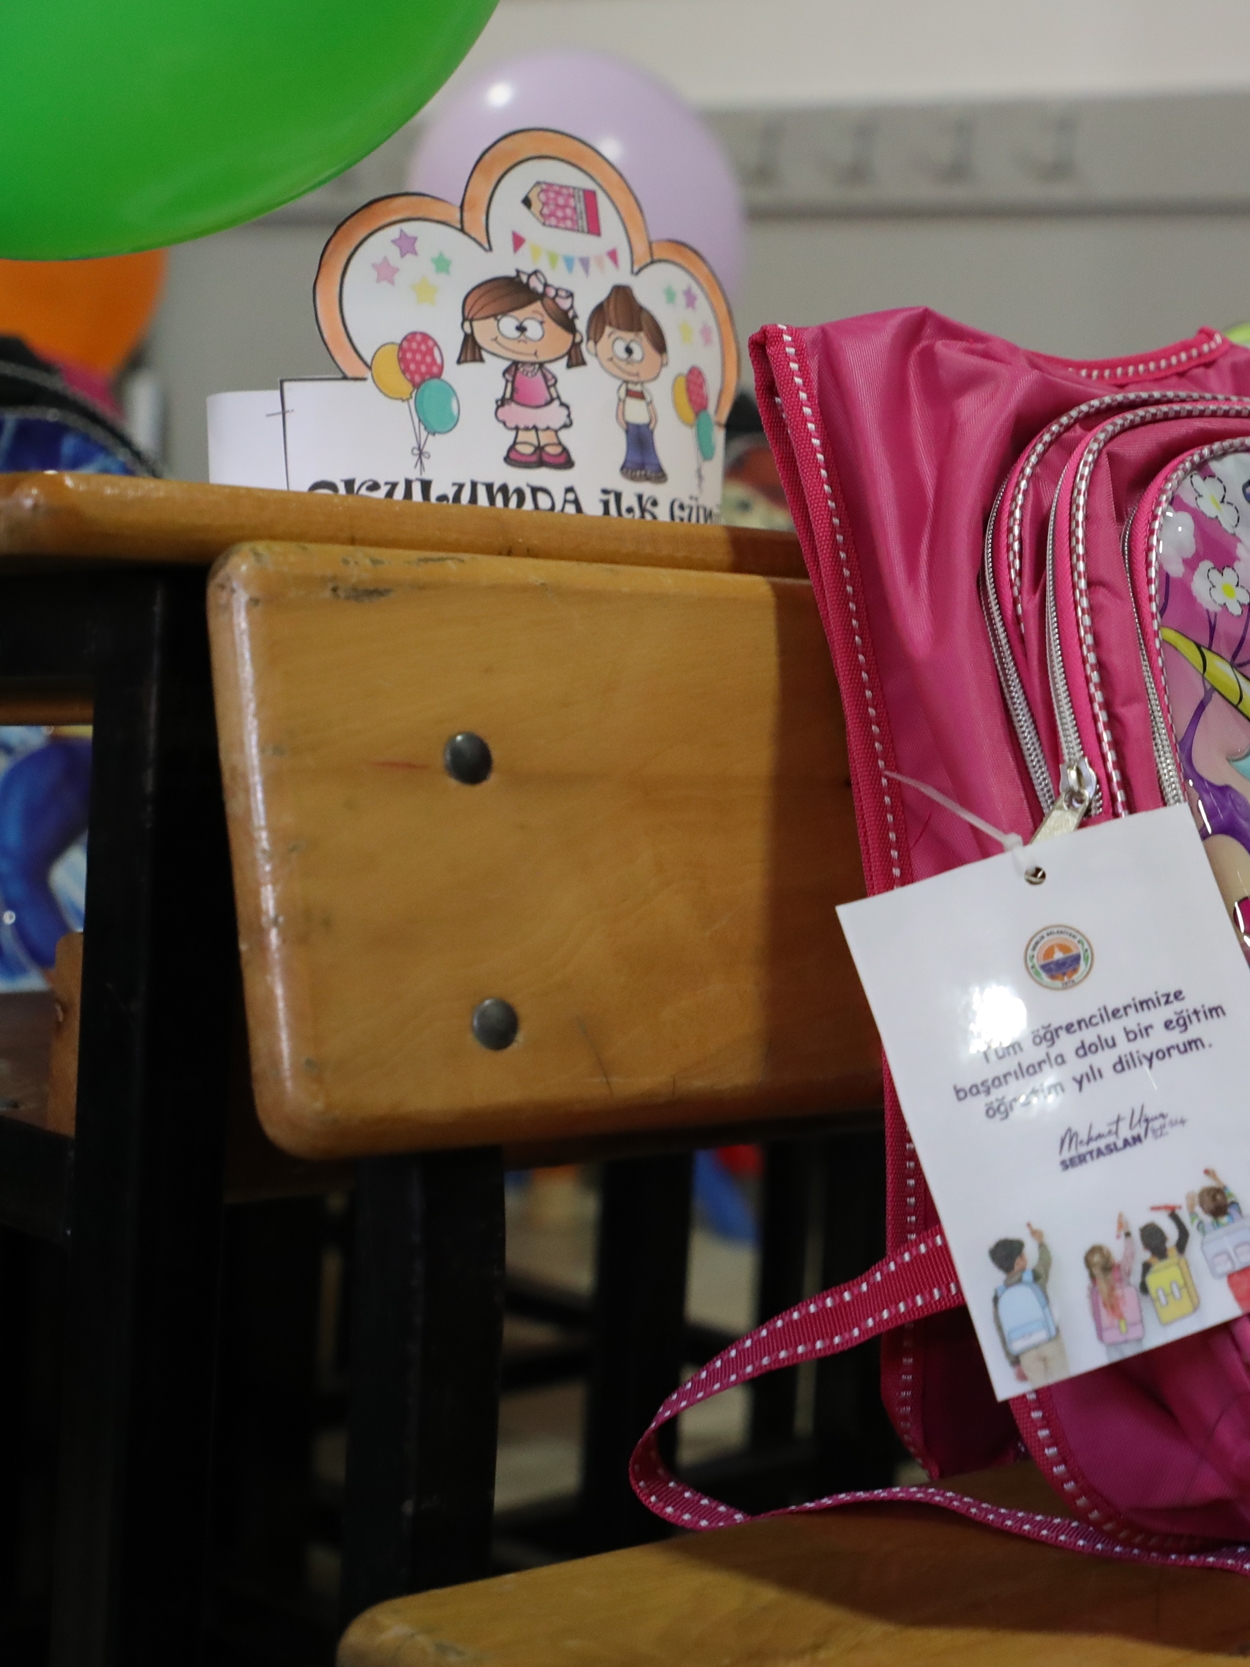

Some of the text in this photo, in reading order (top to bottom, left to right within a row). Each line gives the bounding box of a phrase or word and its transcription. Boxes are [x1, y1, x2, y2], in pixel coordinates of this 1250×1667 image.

[1031, 987, 1186, 1048] öğrencilerimize
[953, 1002, 1227, 1102] başarılarla dolu bir eğitim
[1072, 1065, 1104, 1093] yılı
[1112, 1034, 1213, 1075] diliyorum.
[1059, 1132, 1144, 1172] SERTASLAN
